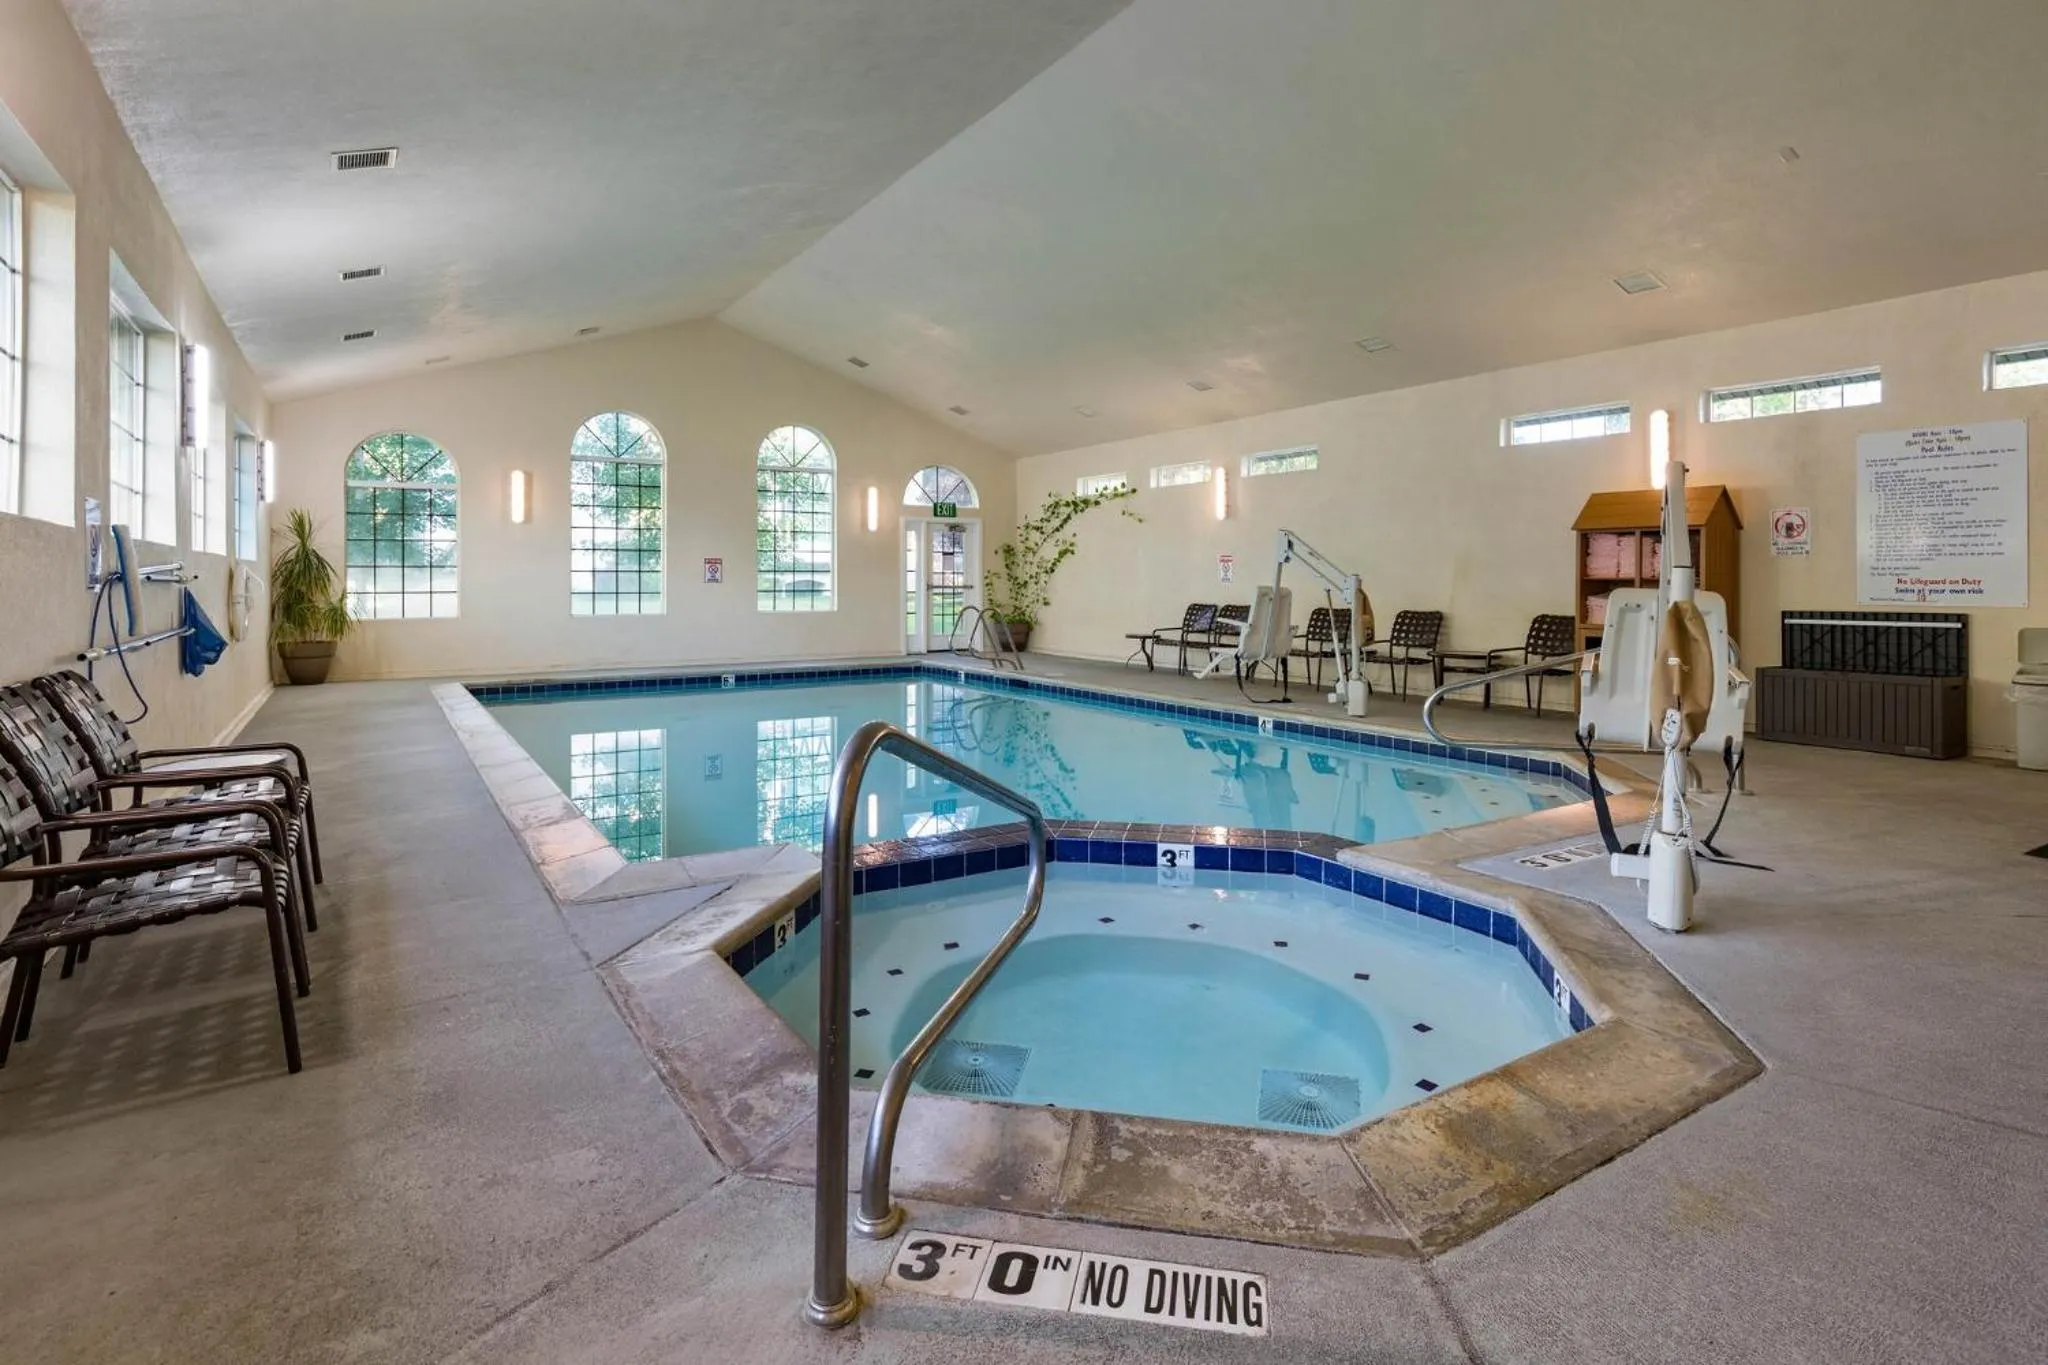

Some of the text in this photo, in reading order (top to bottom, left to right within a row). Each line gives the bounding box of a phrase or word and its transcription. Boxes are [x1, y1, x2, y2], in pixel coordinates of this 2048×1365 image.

[937, 503, 954, 516] EXIT
[1897, 577, 1907, 585] No
[1910, 577, 1946, 586] Lifeguard
[1961, 577, 1982, 587] Duty
[1161, 849, 1177, 867] 3
[897, 1238, 1264, 1328] 3 FT 0 IN NO DIVING
